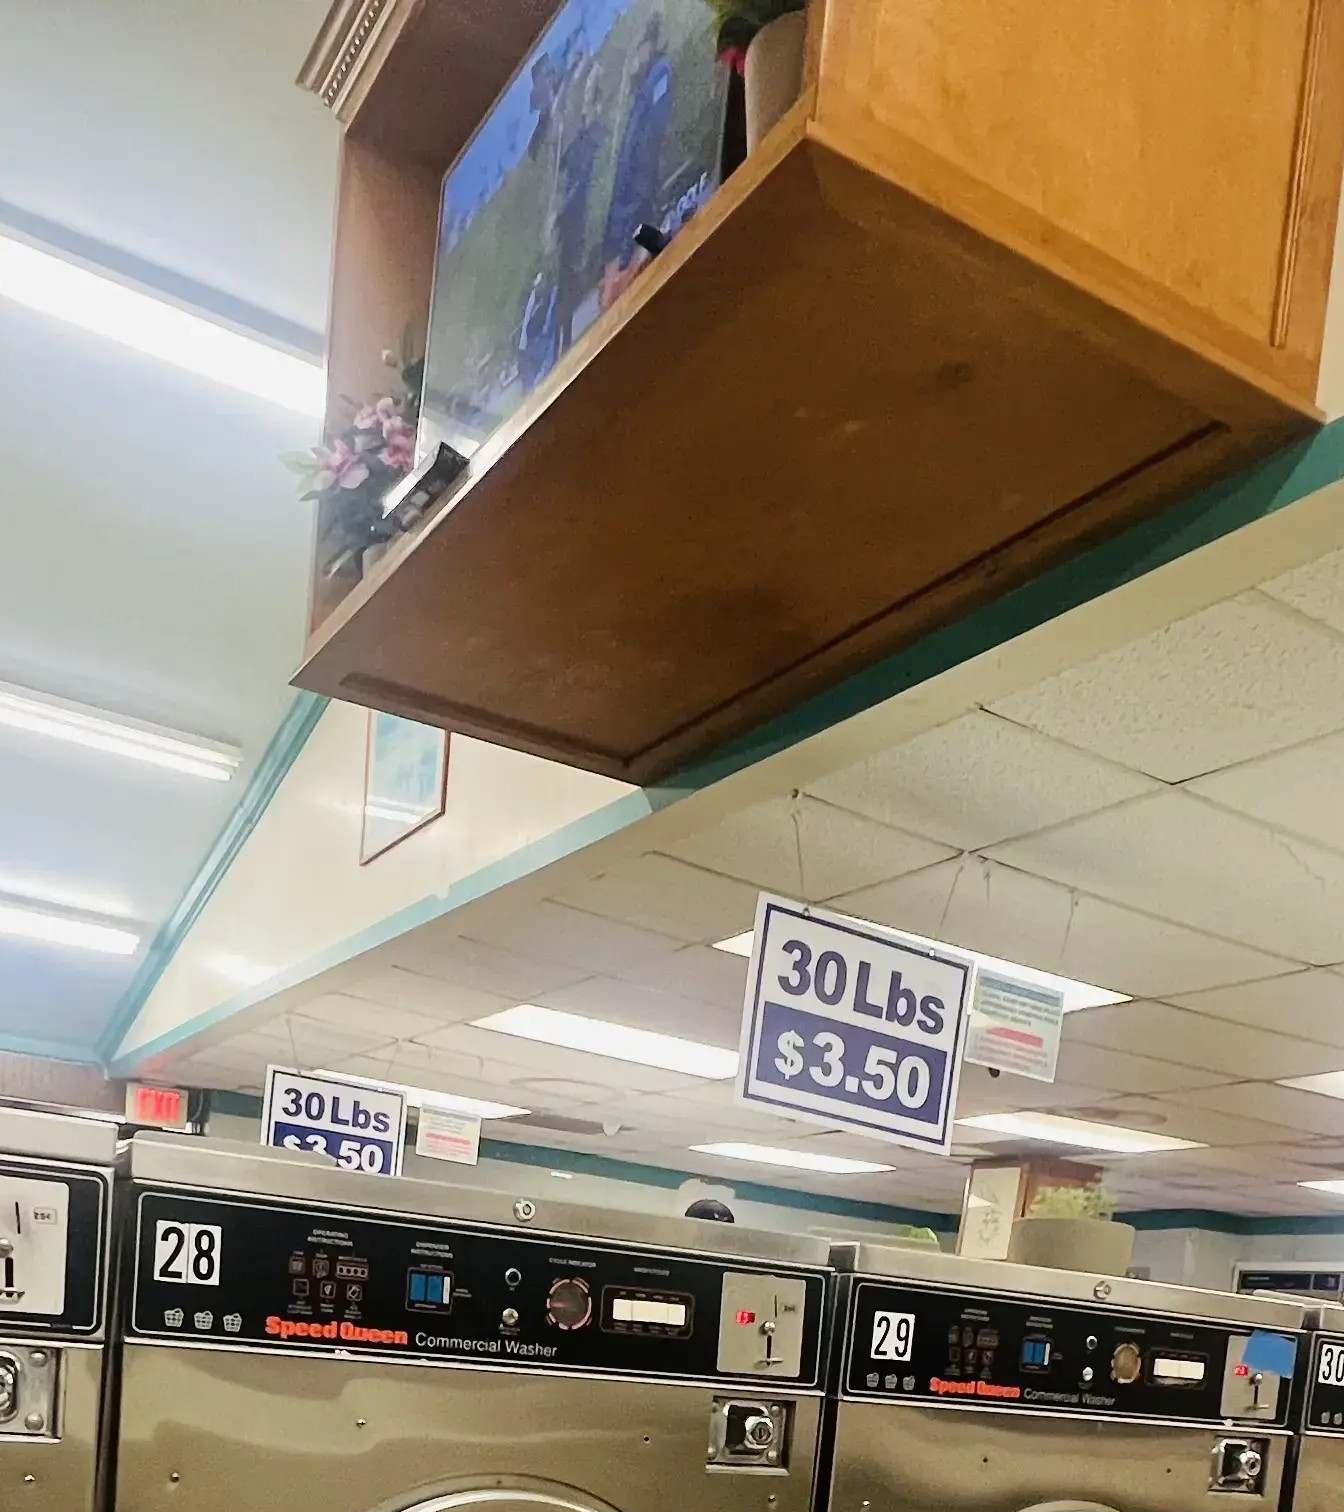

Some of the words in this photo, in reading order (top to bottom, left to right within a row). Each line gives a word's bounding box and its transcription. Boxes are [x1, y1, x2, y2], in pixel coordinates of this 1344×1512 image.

[777, 939, 946, 1035] 30Lbs
[774, 1028, 931, 1110] $3.50
[281, 1087, 391, 1133] 30Lbs
[158, 1227, 215, 1281] 28
[265, 1315, 338, 1340] Speed
[340, 1323, 409, 1345] Queen
[415, 1331, 502, 1354] Commercial
[504, 1338, 558, 1358] Washer
[873, 1315, 911, 1358] 29
